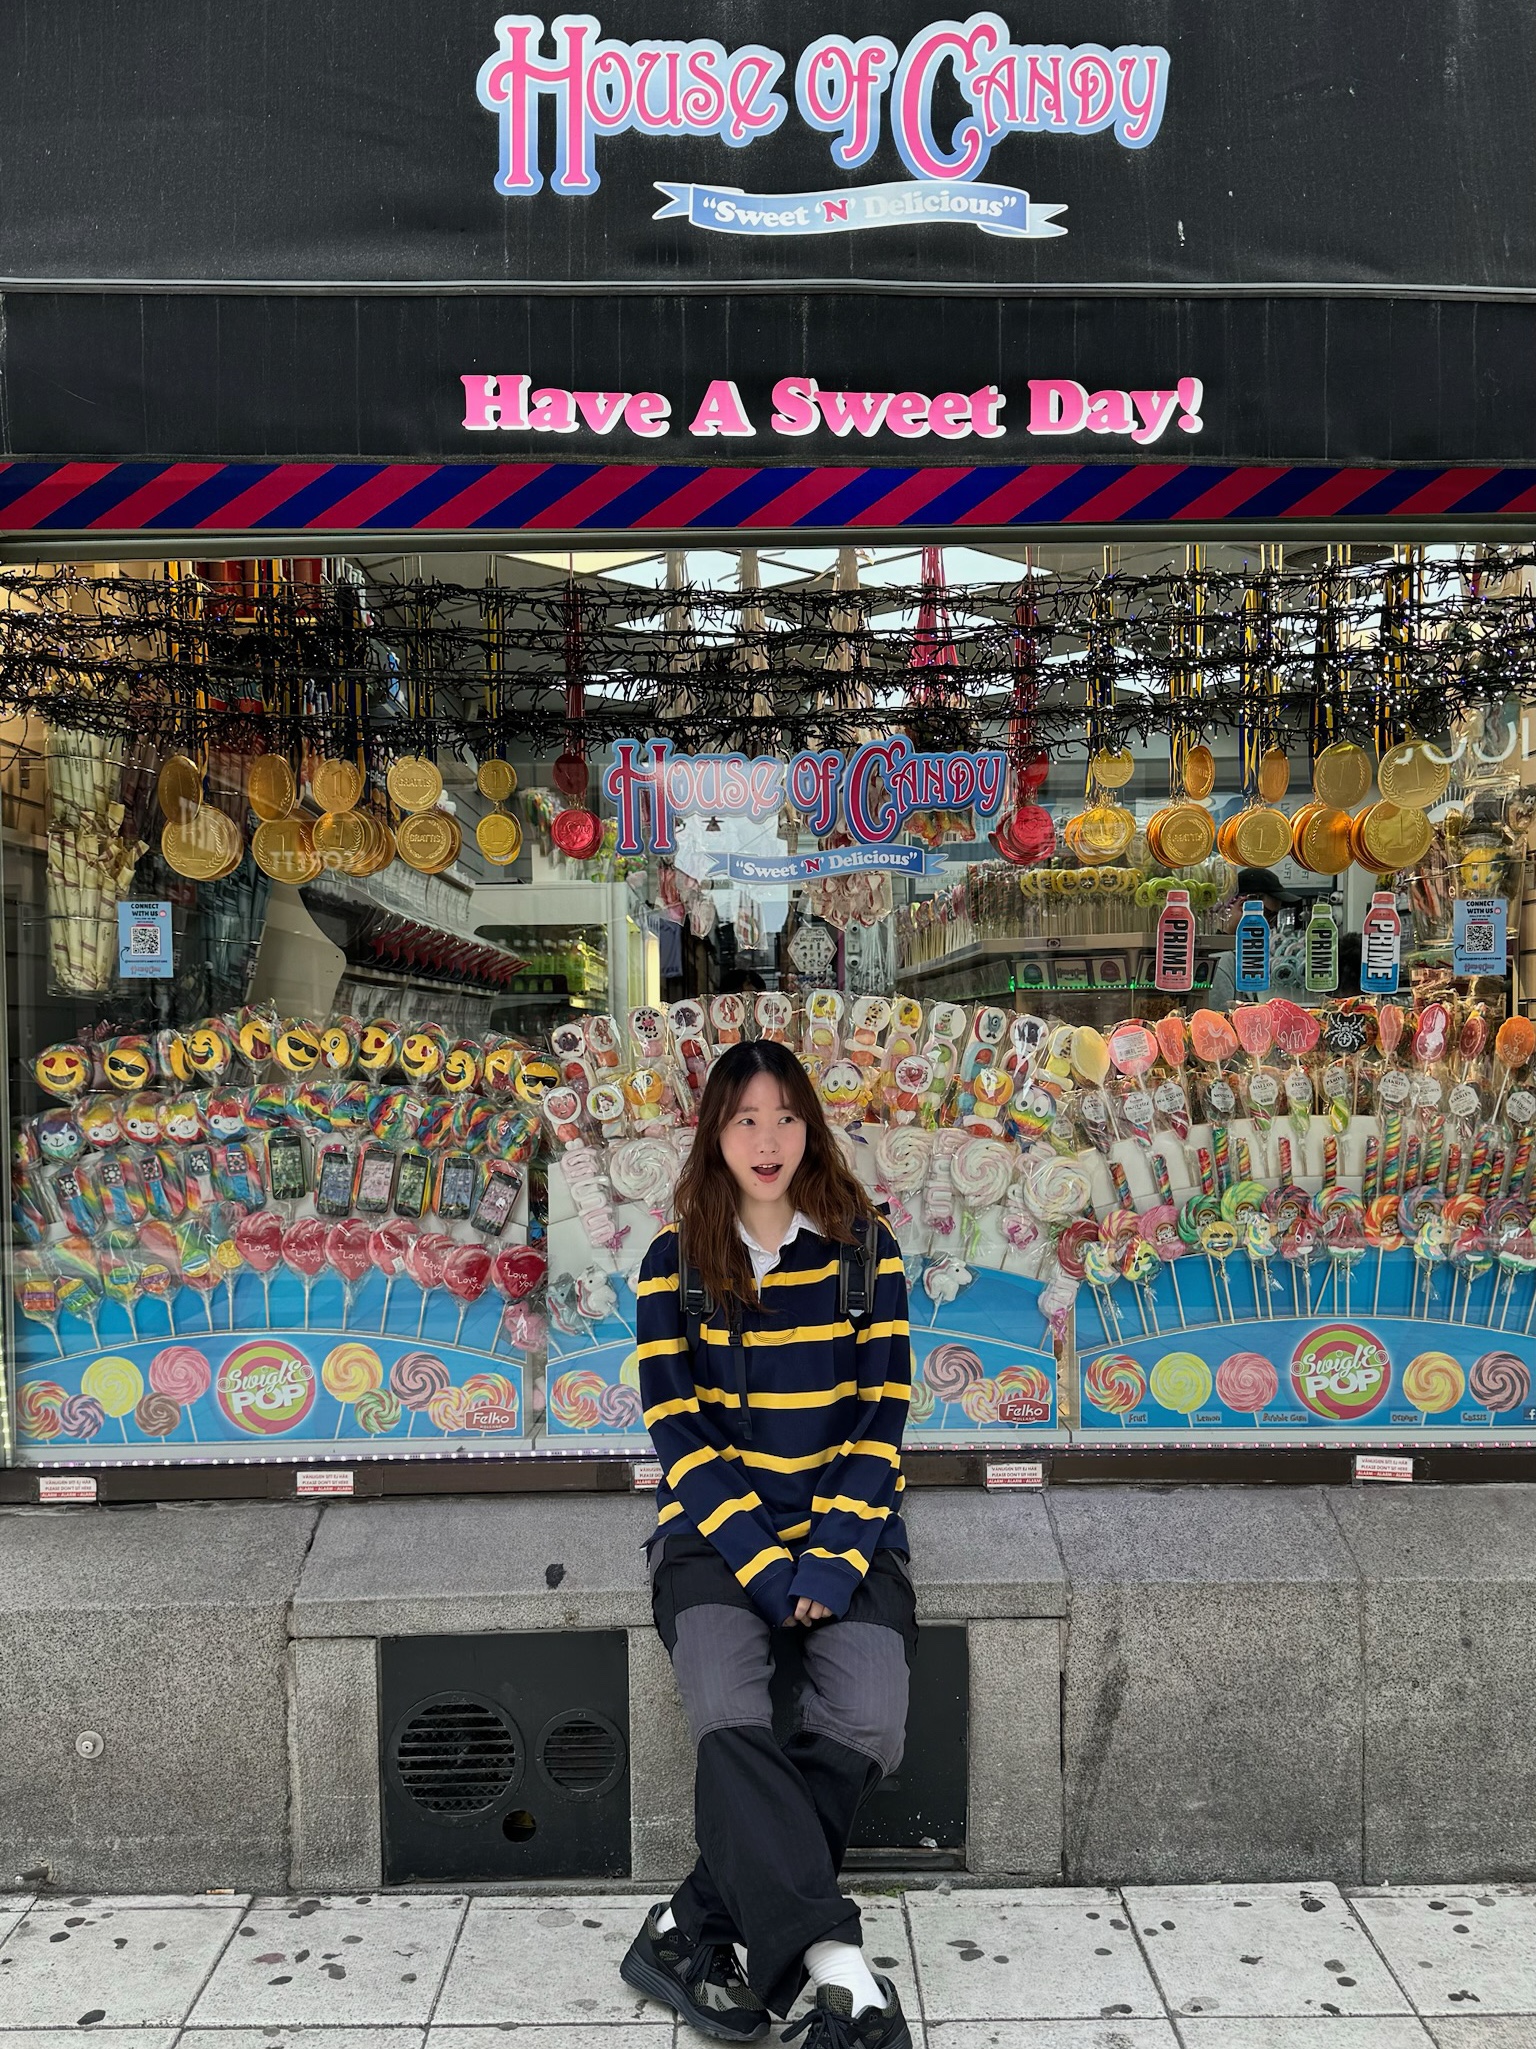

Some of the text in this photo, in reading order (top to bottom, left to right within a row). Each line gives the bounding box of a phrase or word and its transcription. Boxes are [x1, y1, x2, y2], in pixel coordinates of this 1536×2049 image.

[460, 374, 1205, 445] Have A Sweet Day!
[409, 833, 441, 844] GRATTIS
[1163, 919, 1188, 977] PRIME
[1242, 927, 1265, 980] PRIME
[1367, 918, 1396, 981] PRIME
[1311, 929, 1333, 979] PRIME
[250, 1243, 271, 1251] Love
[296, 1249, 317, 1257] Love
[343, 1251, 363, 1259] Love
[508, 1269, 529, 1279] Love
[458, 1276, 477, 1284] Love
[1305, 1368, 1381, 1399] POP
[231, 1383, 306, 1415] POP
[1005, 1404, 1043, 1417] Felko
[472, 1411, 510, 1425] Felko
[1128, 1413, 1147, 1423] Fruit
[1196, 1413, 1221, 1422] Lemon
[1262, 1413, 1308, 1422] Bubble Gum
[1462, 1412, 1487, 1421] Cassis
